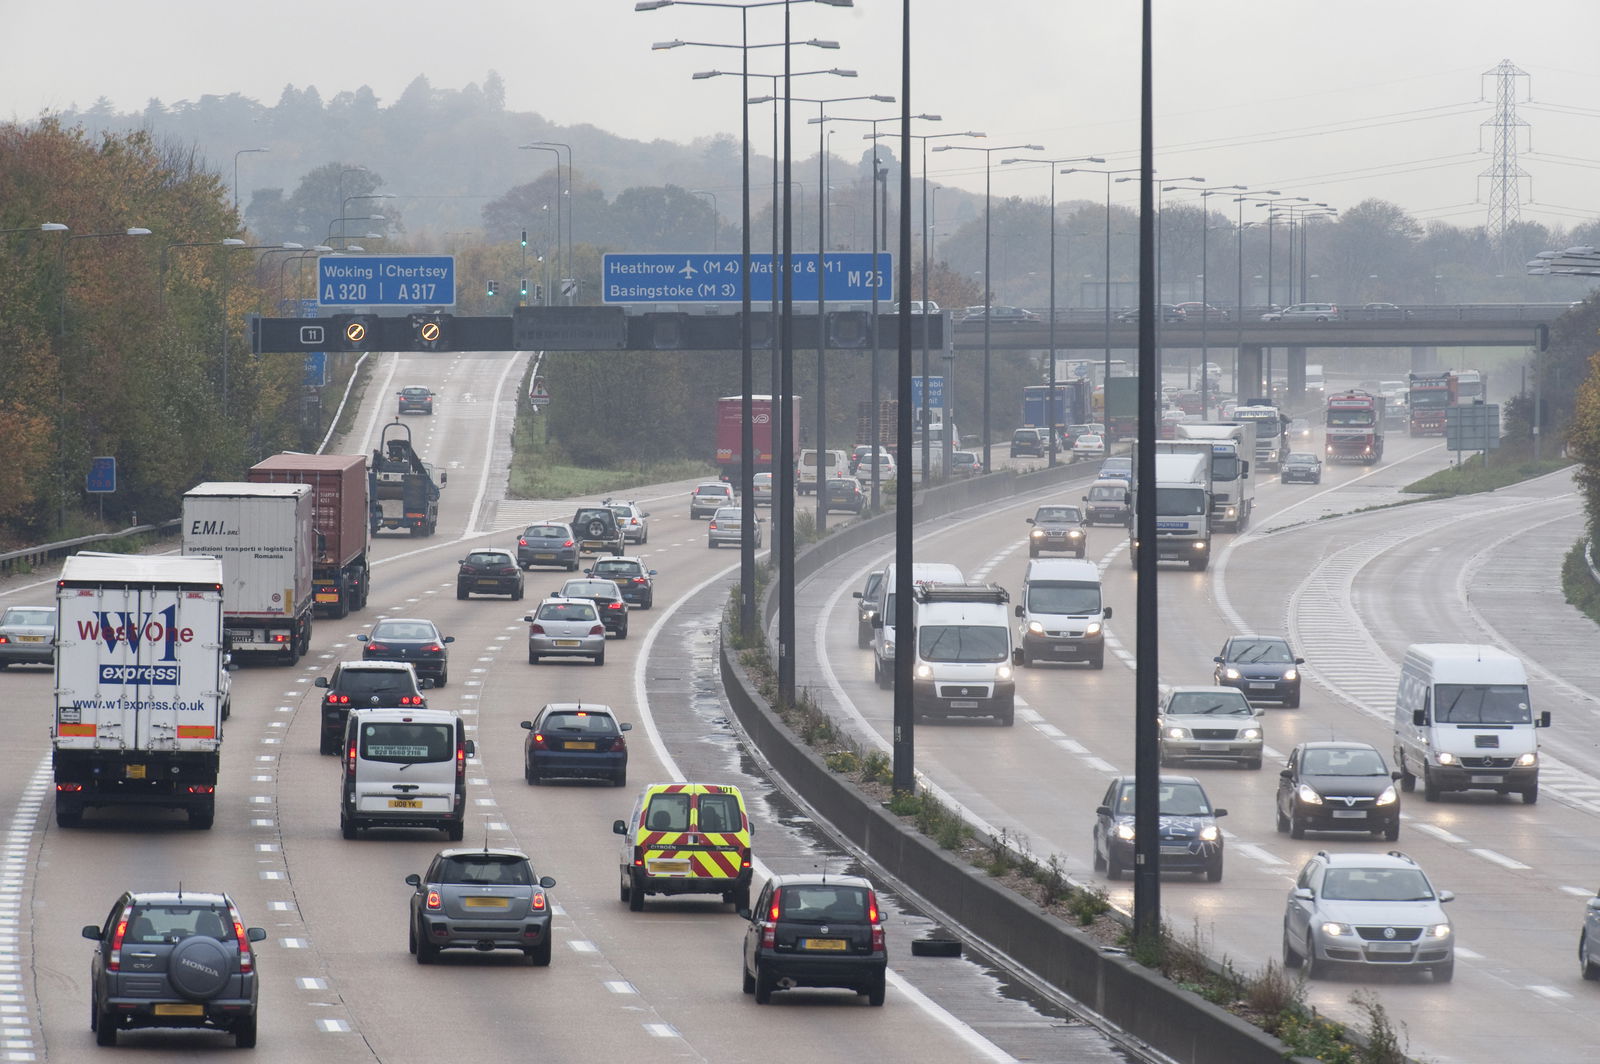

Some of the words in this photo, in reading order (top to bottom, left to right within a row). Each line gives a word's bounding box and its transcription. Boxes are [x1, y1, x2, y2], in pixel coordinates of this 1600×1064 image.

[324, 265, 373, 279] Woking
[386, 264, 448, 279] Chertsey
[610, 262, 675, 274] Heathrow
[749, 261, 802, 273] Watd
[806, 261, 816, 273] &
[848, 271, 860, 287] M
[324, 284, 335, 300] A
[339, 283, 366, 300] 320
[398, 284, 409, 300] A
[412, 283, 436, 300] 317
[610, 284, 694, 299] Basingstoke
[308, 330, 317, 340] 11
[191, 520, 226, 535] E.M.I.
[77, 620, 138, 641] West
[145, 621, 194, 643] One
[102, 666, 177, 683] express
[73, 699, 204, 711] www.w1express.co.uk
[182, 958, 219, 977] HONDA
